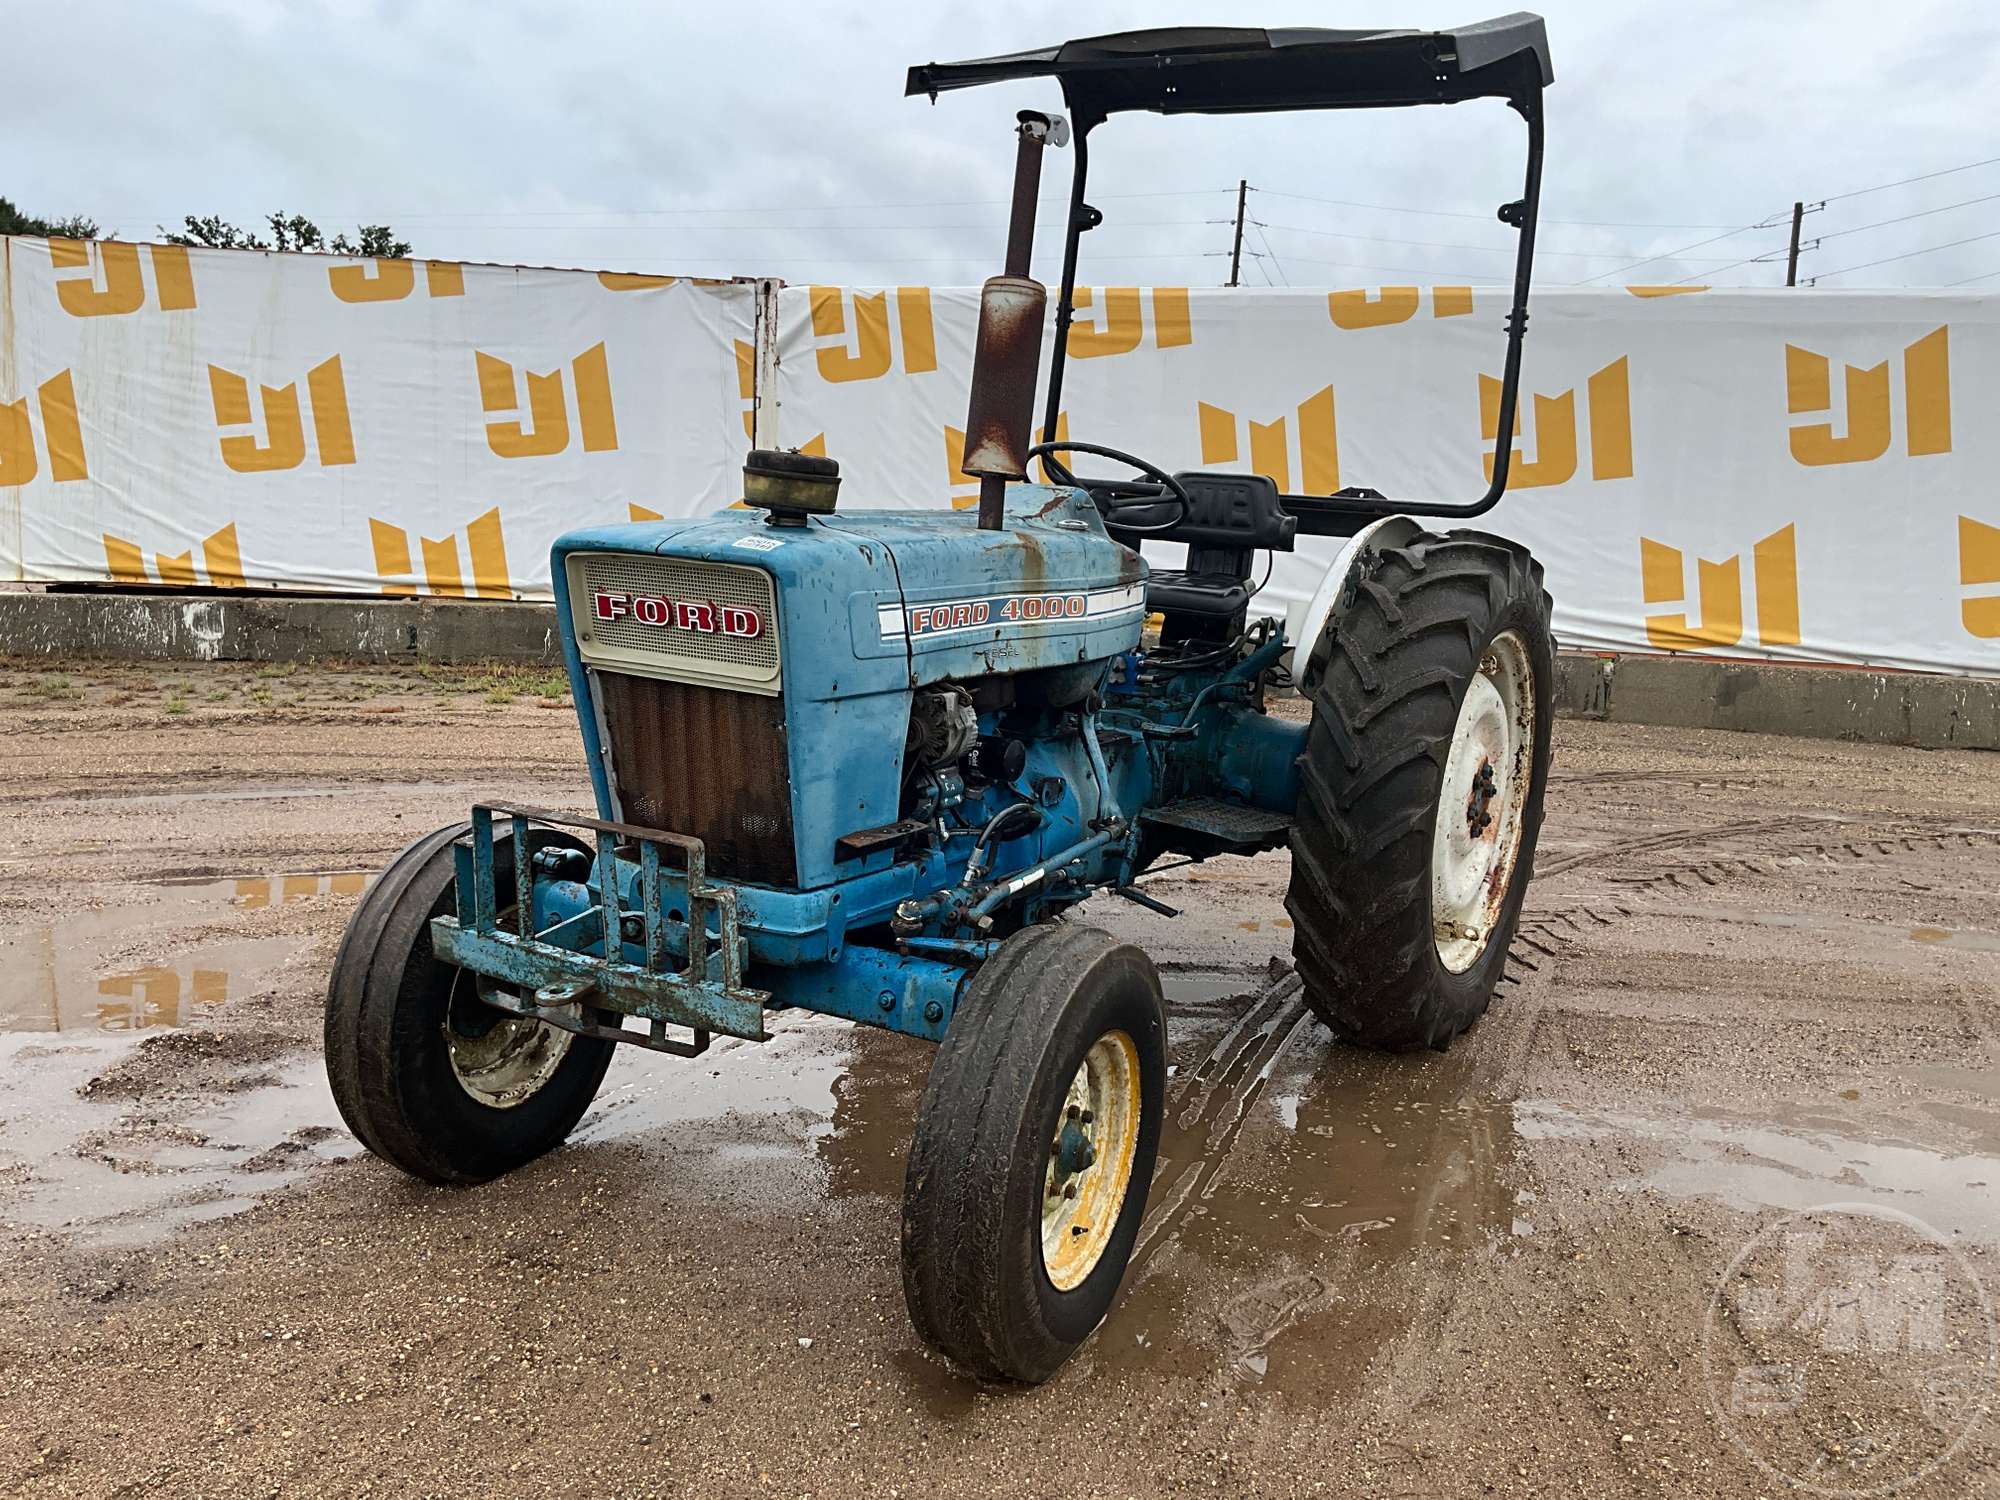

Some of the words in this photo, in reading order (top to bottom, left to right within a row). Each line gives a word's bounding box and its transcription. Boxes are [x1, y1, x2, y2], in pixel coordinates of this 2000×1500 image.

[594, 592, 762, 638] FORD
[912, 602, 990, 634] FORD
[1000, 596, 1086, 621] 4000
